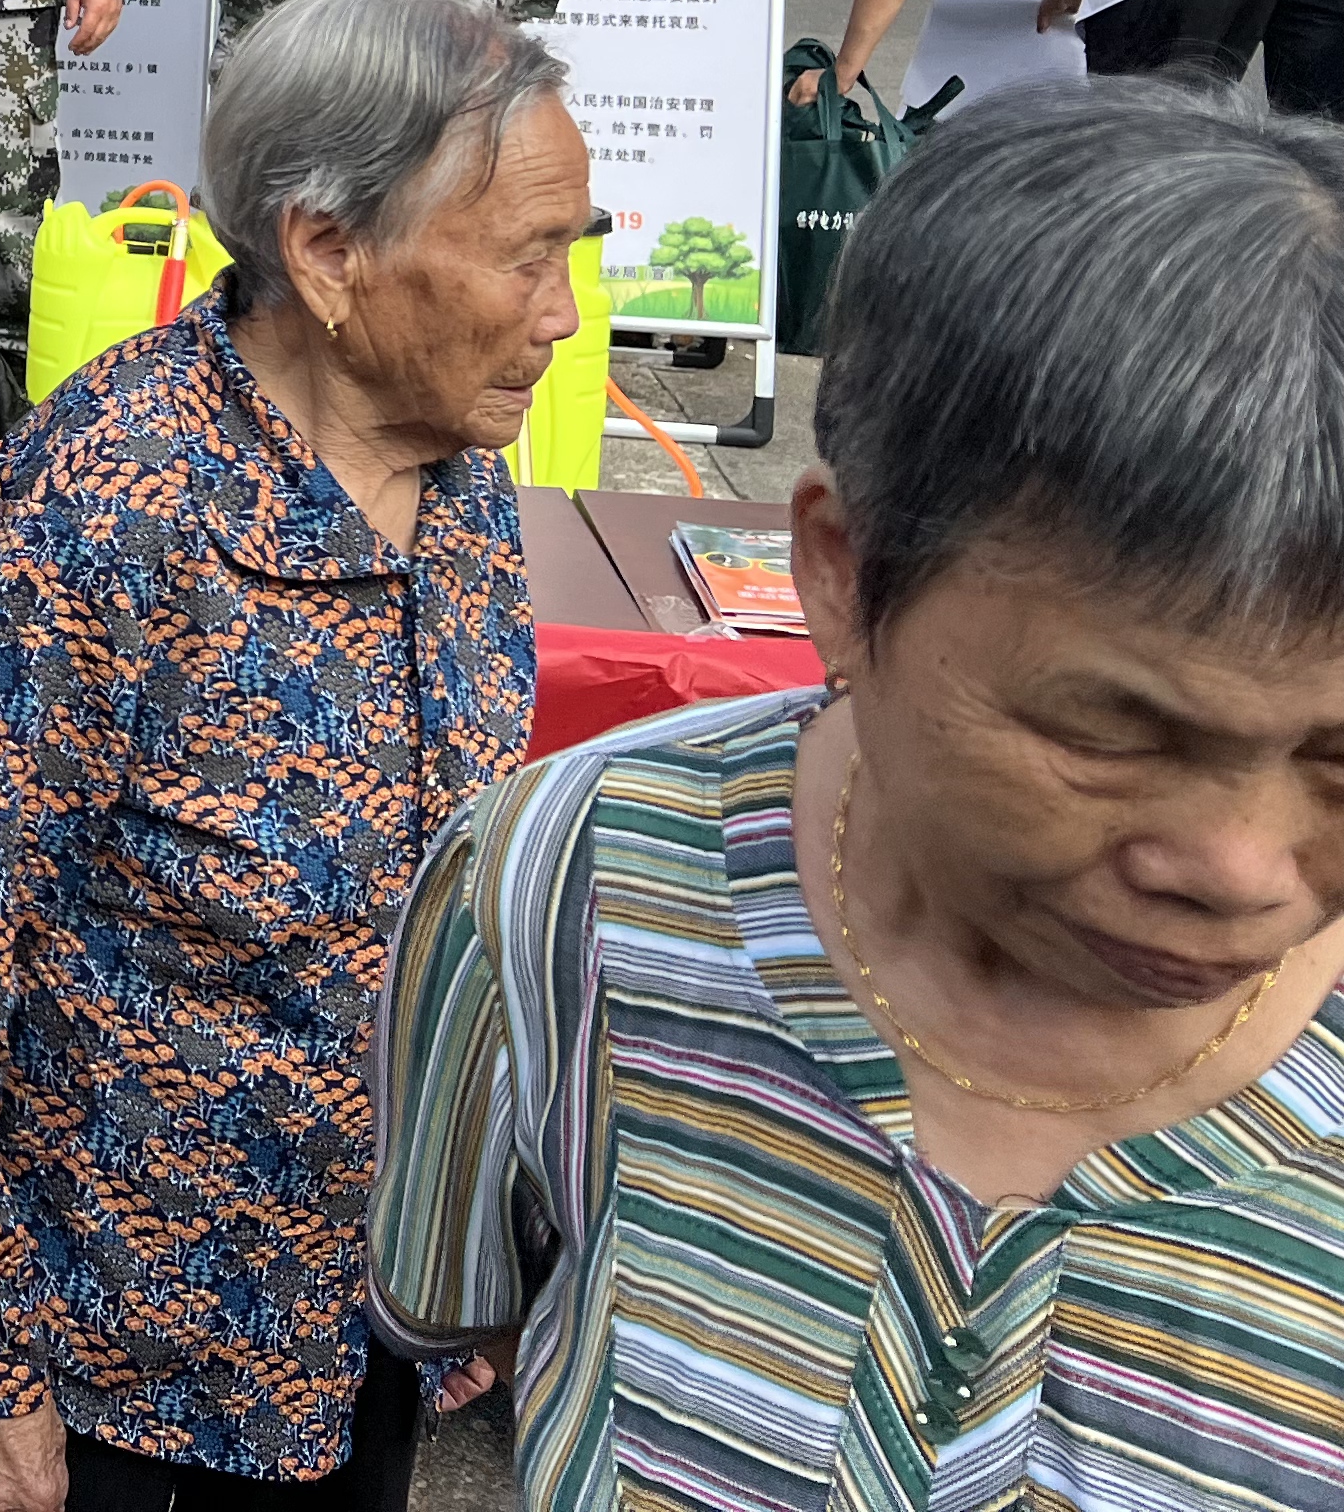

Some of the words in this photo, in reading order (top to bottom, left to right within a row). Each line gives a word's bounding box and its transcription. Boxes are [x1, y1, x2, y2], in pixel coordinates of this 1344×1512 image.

[569, 94, 715, 113] 人民共和国治安管理
[616, 211, 643, 230] 19
